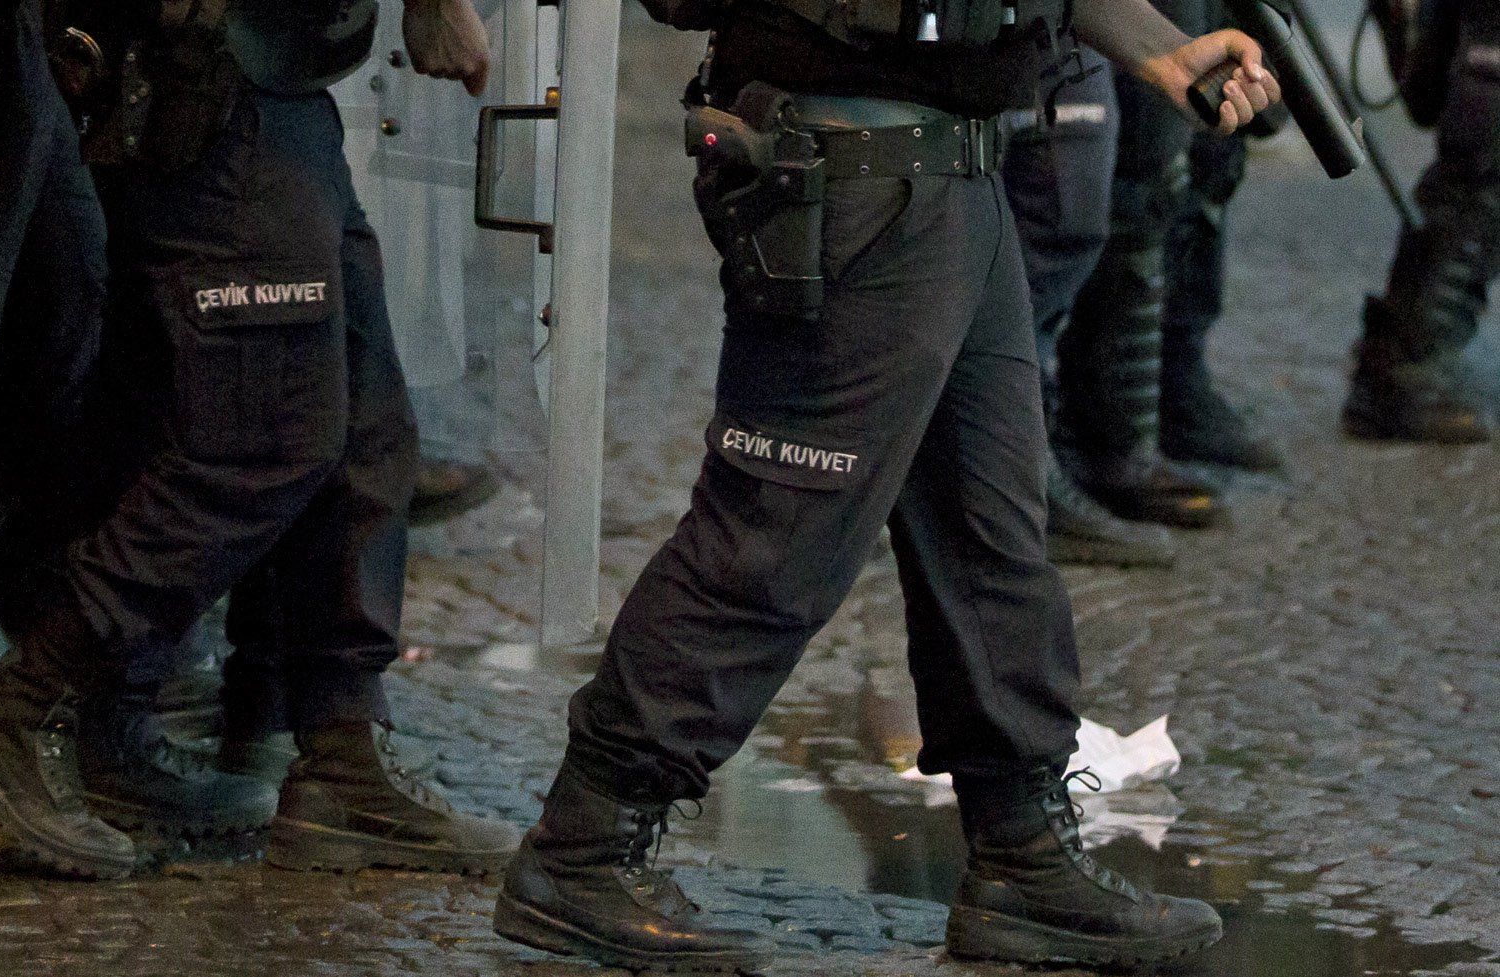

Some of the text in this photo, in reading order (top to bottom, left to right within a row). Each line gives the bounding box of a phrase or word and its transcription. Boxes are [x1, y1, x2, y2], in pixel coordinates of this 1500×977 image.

[195, 281, 326, 313] ÇEVİK KUVVET
[722, 427, 858, 474] ÇEVİK KUVVET
